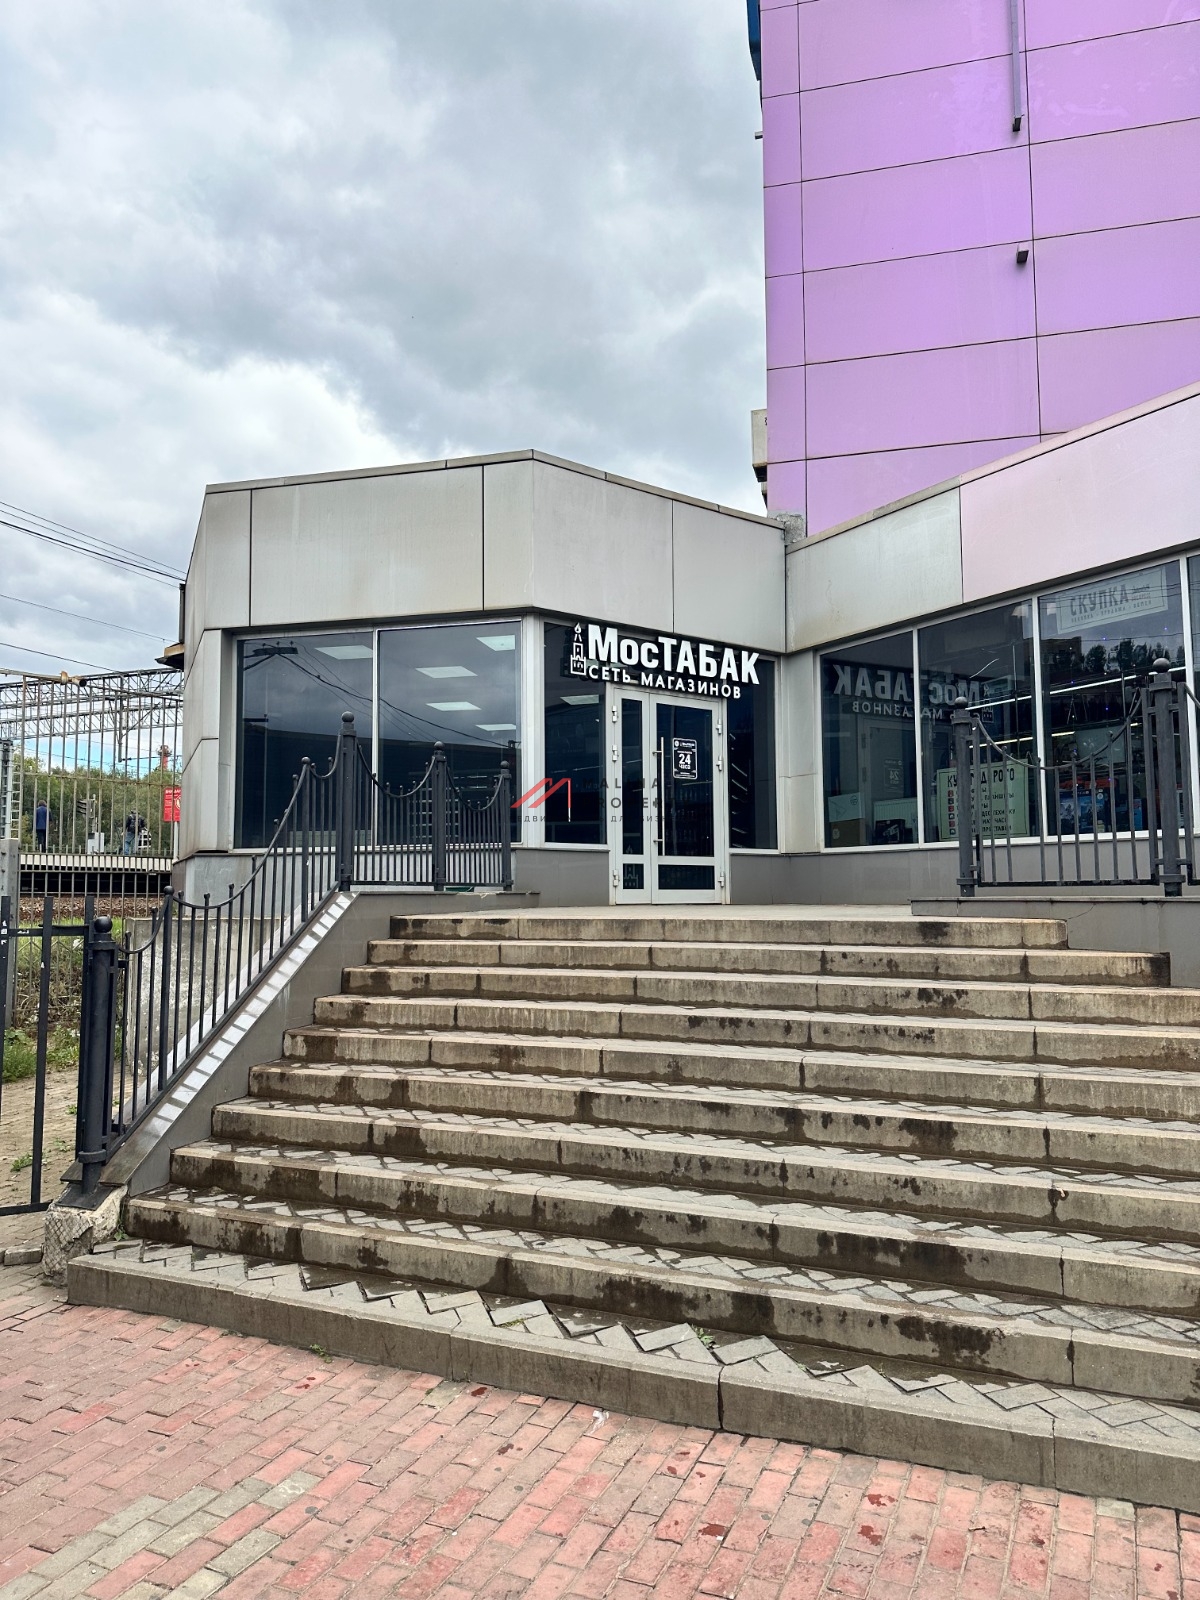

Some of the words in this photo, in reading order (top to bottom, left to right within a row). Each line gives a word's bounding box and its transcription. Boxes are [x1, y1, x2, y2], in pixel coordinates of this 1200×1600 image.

[1070, 584, 1129, 616] СКУПКА
[588, 664, 631, 684] СЕТЬ
[641, 672, 742, 699] МАГАЗИНОВ
[678, 753, 691, 765] 24
